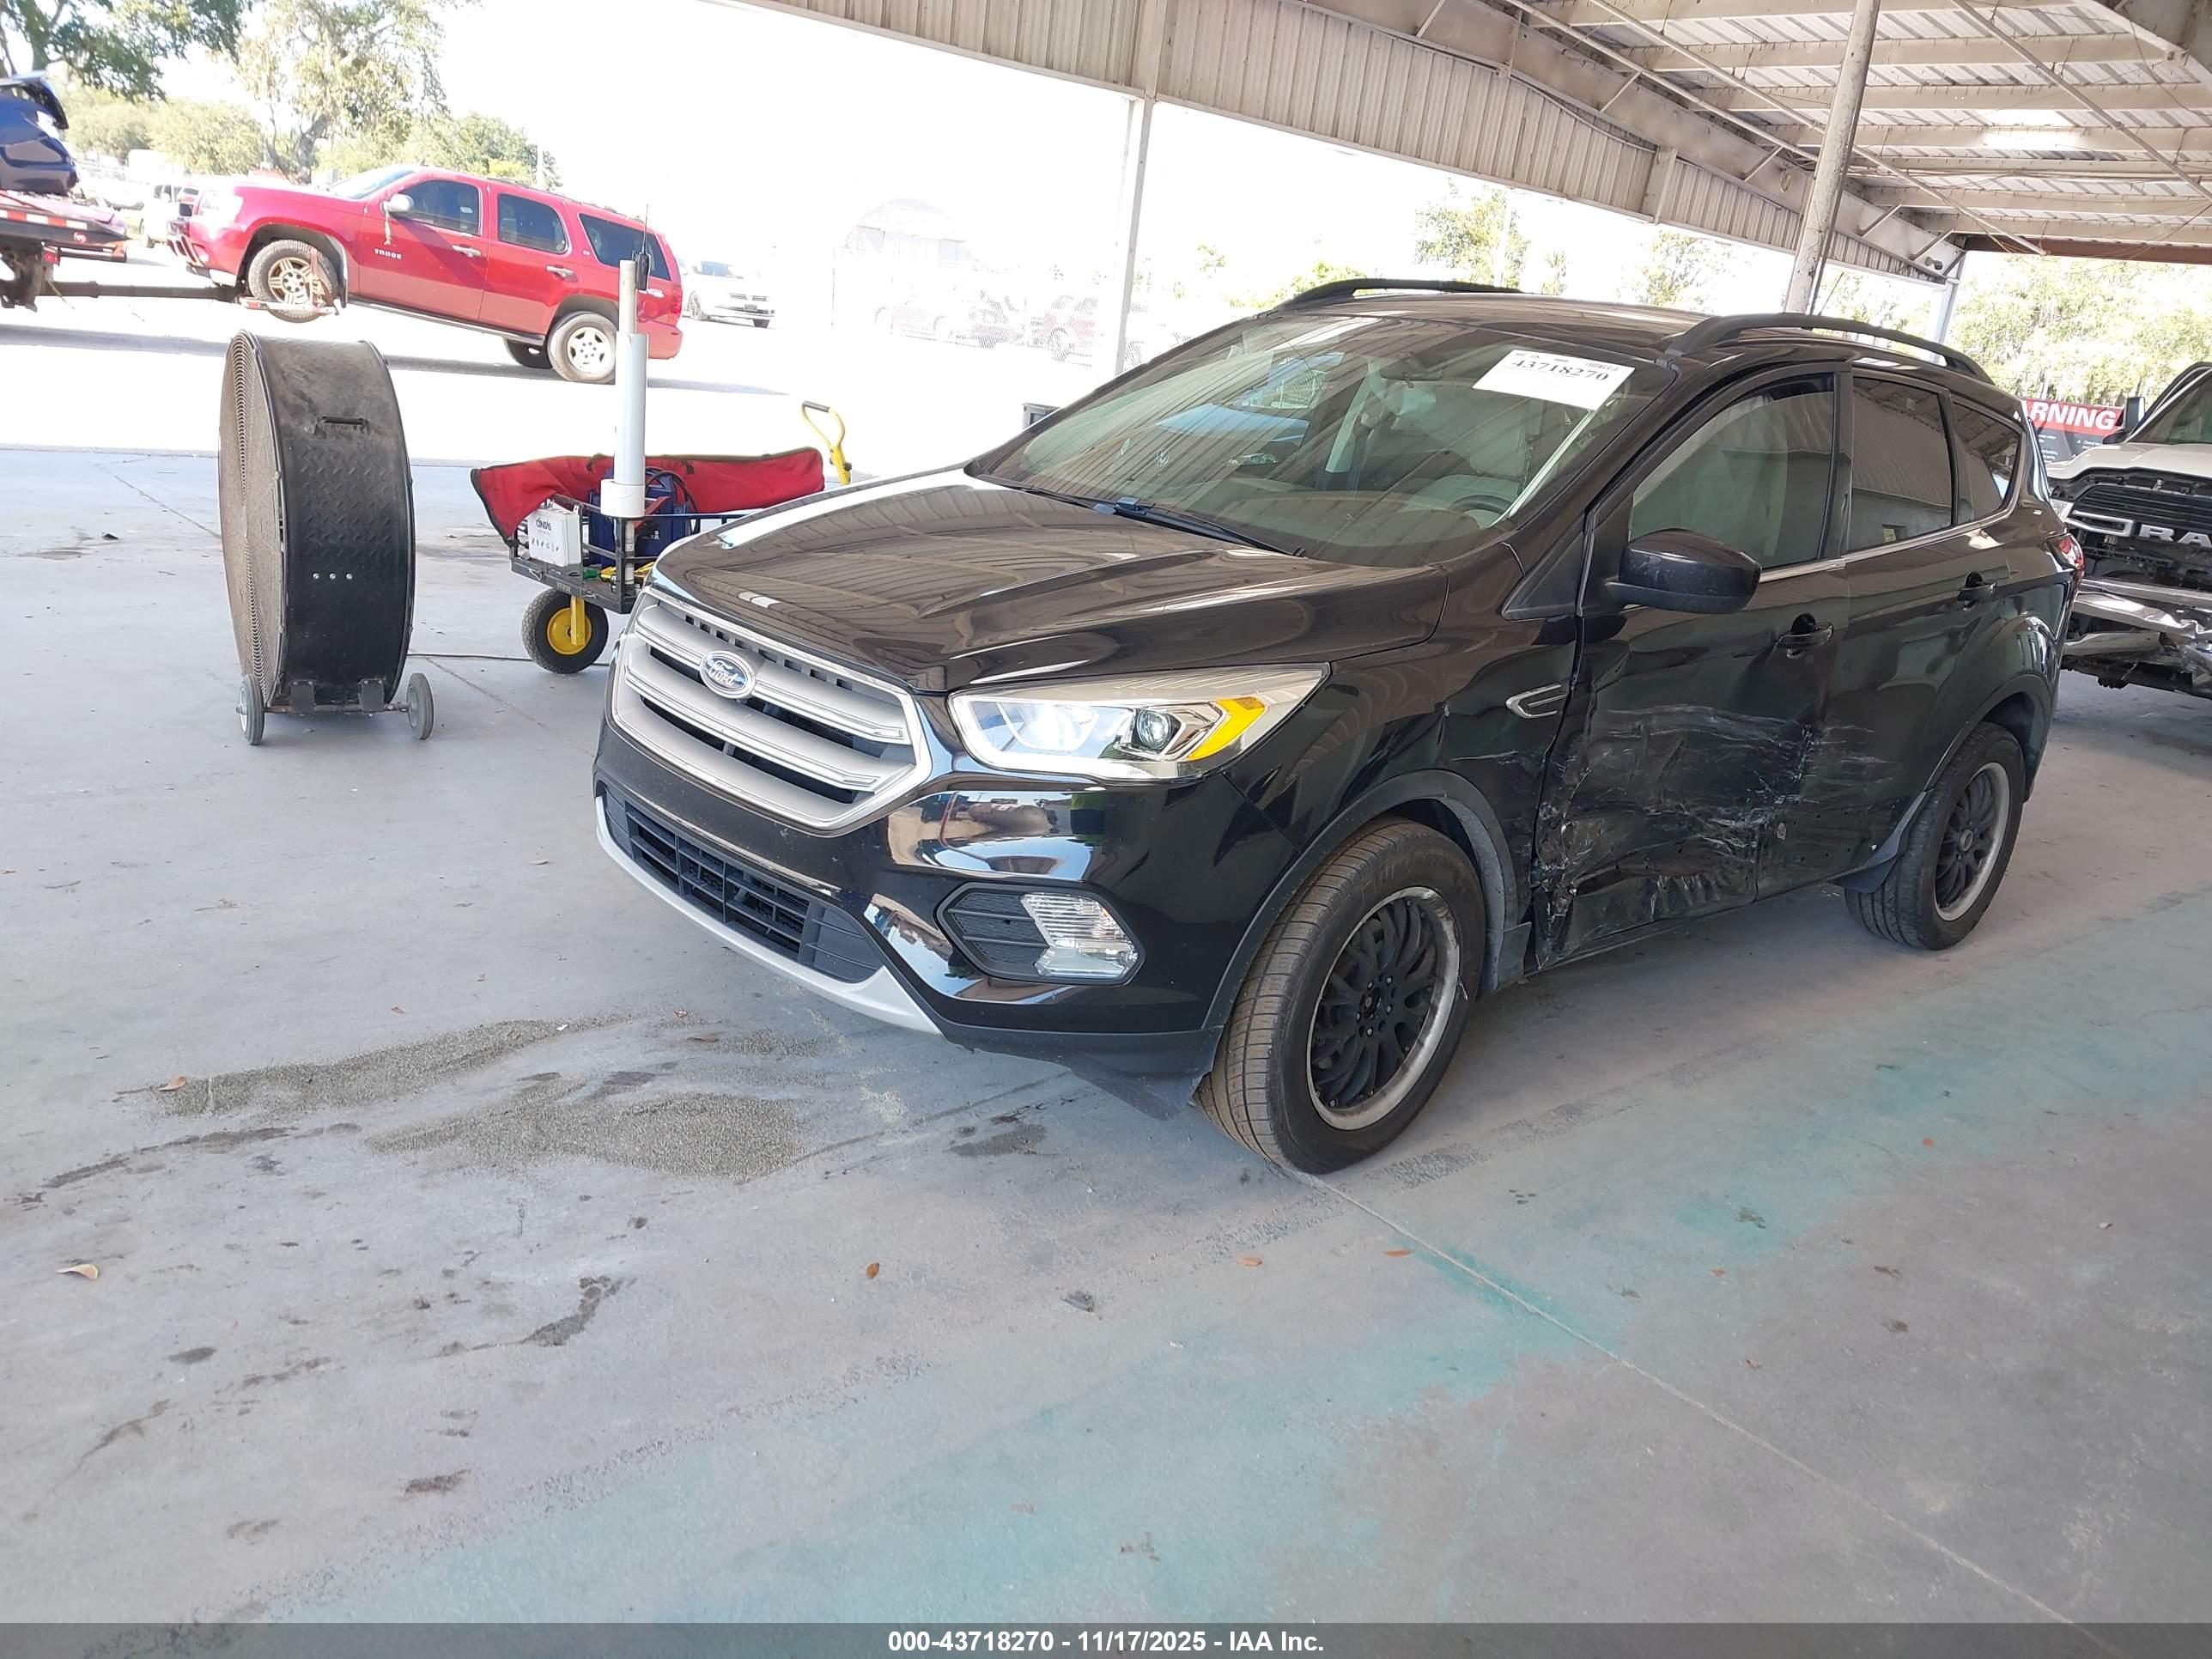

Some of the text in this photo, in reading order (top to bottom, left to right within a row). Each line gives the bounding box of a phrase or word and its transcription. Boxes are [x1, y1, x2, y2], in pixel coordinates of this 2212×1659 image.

[374, 247, 402, 259] TAHOE
[1512, 360, 1609, 380] 43718270
[708, 659, 738, 687] Ford
